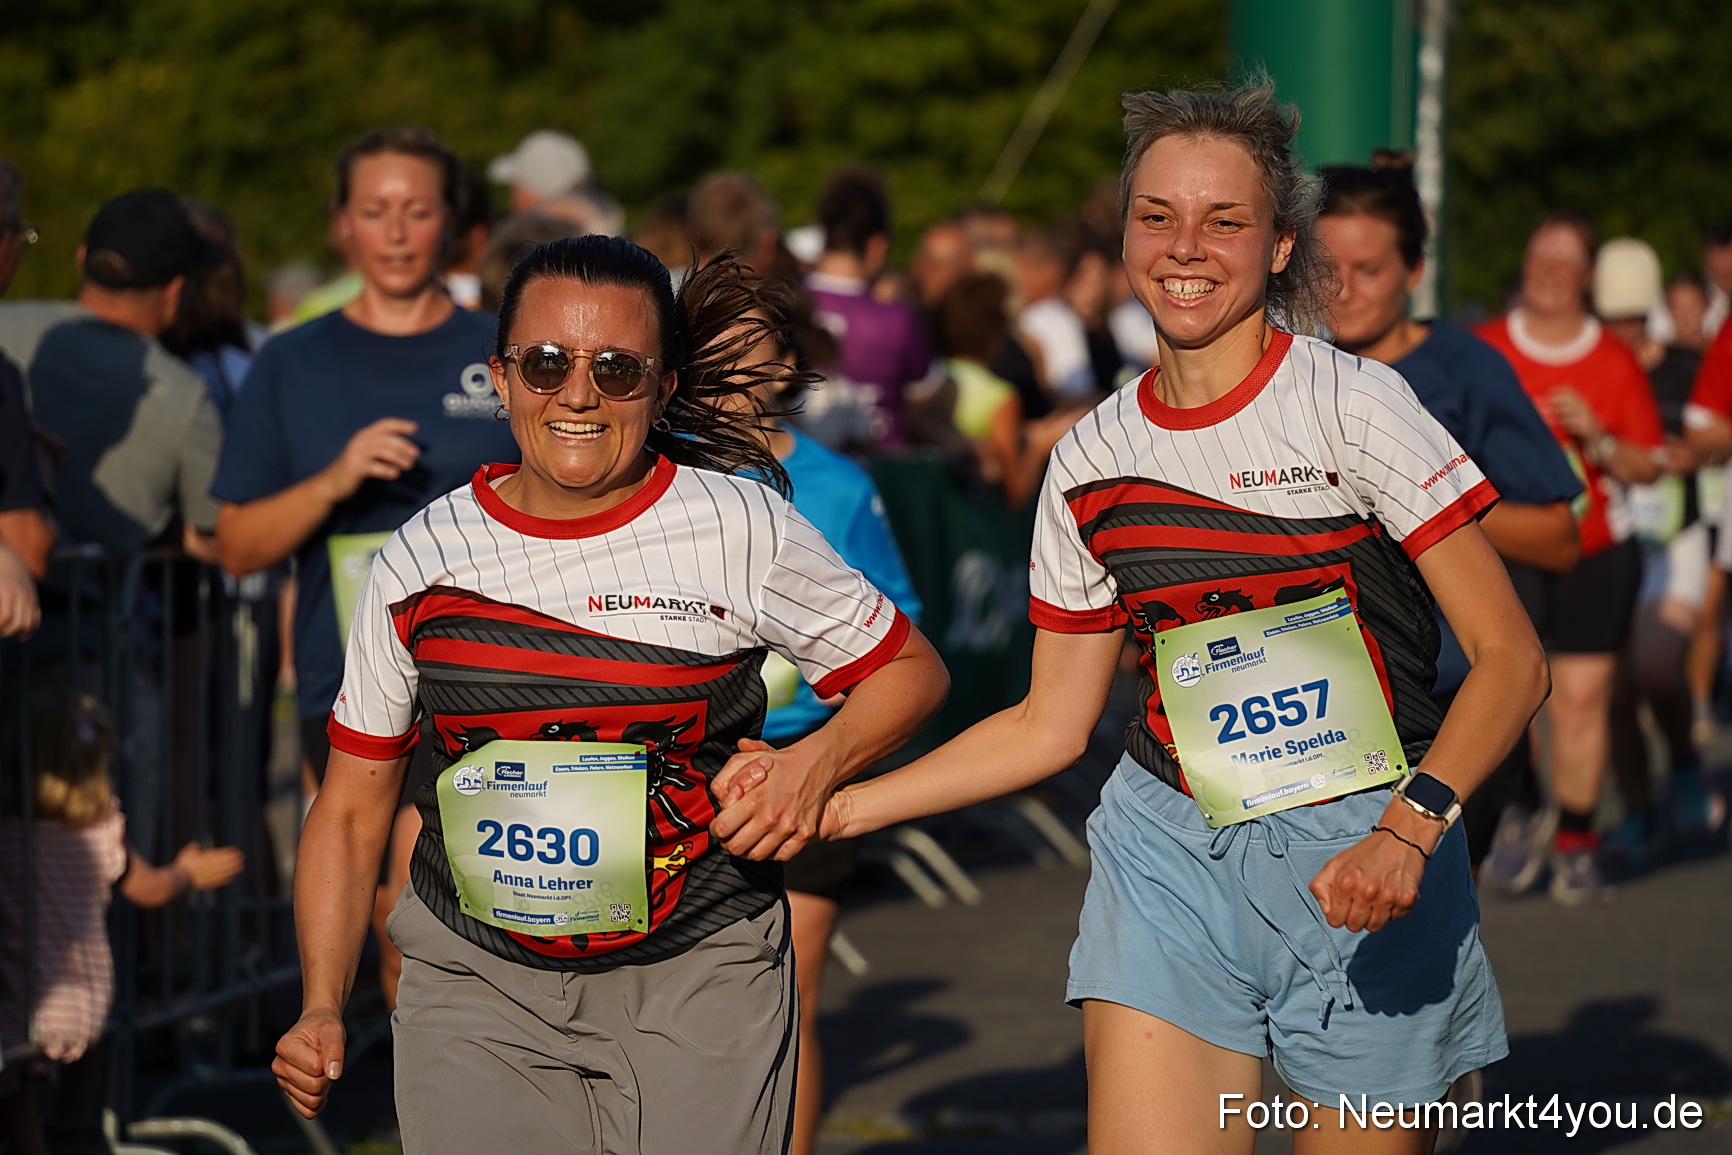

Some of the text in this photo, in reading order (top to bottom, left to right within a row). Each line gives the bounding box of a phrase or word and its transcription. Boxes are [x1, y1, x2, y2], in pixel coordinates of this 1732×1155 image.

[1287, 487, 1312, 495] STARKE
[588, 595, 706, 616] NEUMARKT
[1205, 647, 1265, 674] Firmenlauf
[1231, 657, 1267, 673] neumarkt
[1208, 678, 1329, 744] 2657
[1231, 729, 1347, 769] Marie Spelda
[486, 780, 548, 791] Firmenlauf
[1245, 782, 1309, 807] firmenlauf.bayern
[476, 819, 599, 866] 2630
[493, 869, 593, 890] Anna Lehrer
[495, 910, 551, 924] firmenlauf.bayern
